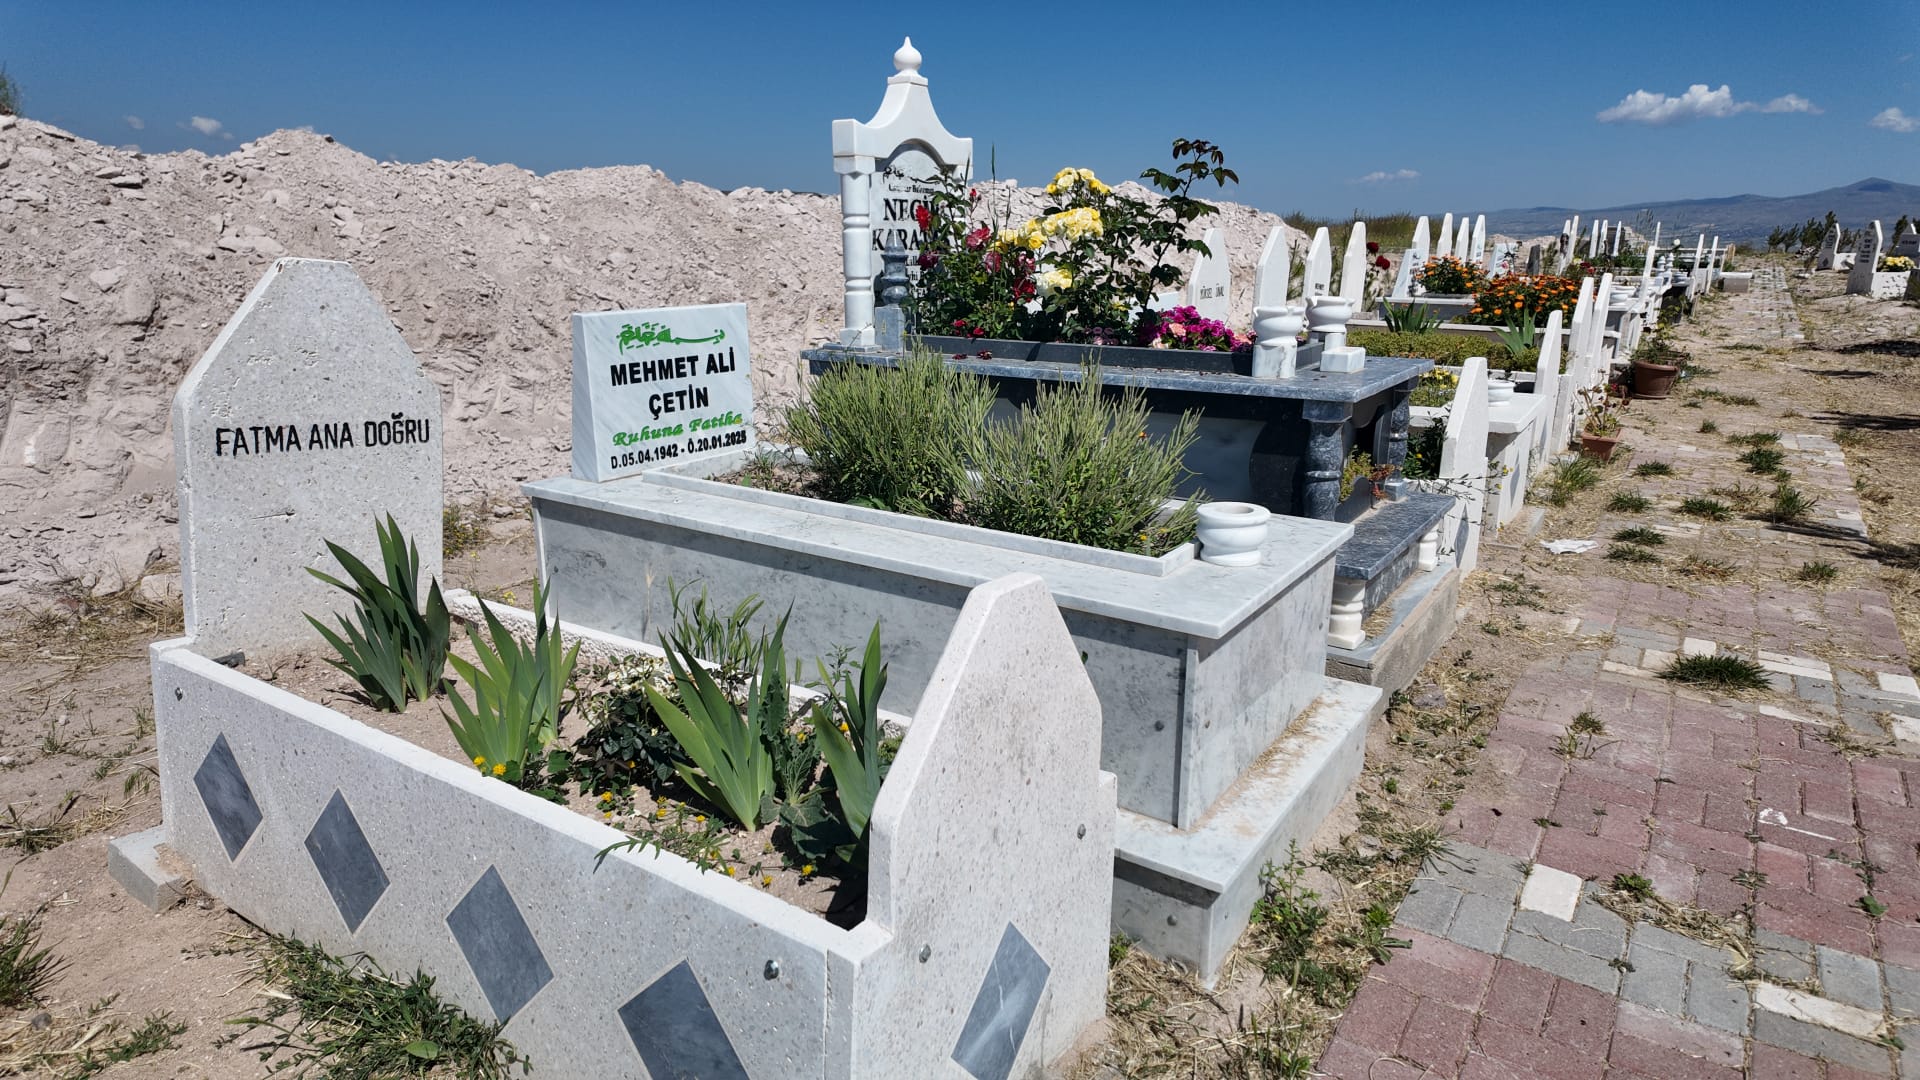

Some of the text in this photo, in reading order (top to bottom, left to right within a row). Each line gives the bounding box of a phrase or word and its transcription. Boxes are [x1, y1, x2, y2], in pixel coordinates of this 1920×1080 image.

[610, 347, 736, 386] MEHMET ALİ
[648, 384, 709, 420] ÇETİN
[215, 411, 430, 457] FATMA ANA DOĞRU
[612, 411, 743, 447] Ruhuna Fatiha
[611, 443, 679, 469] D.05.04.1942
